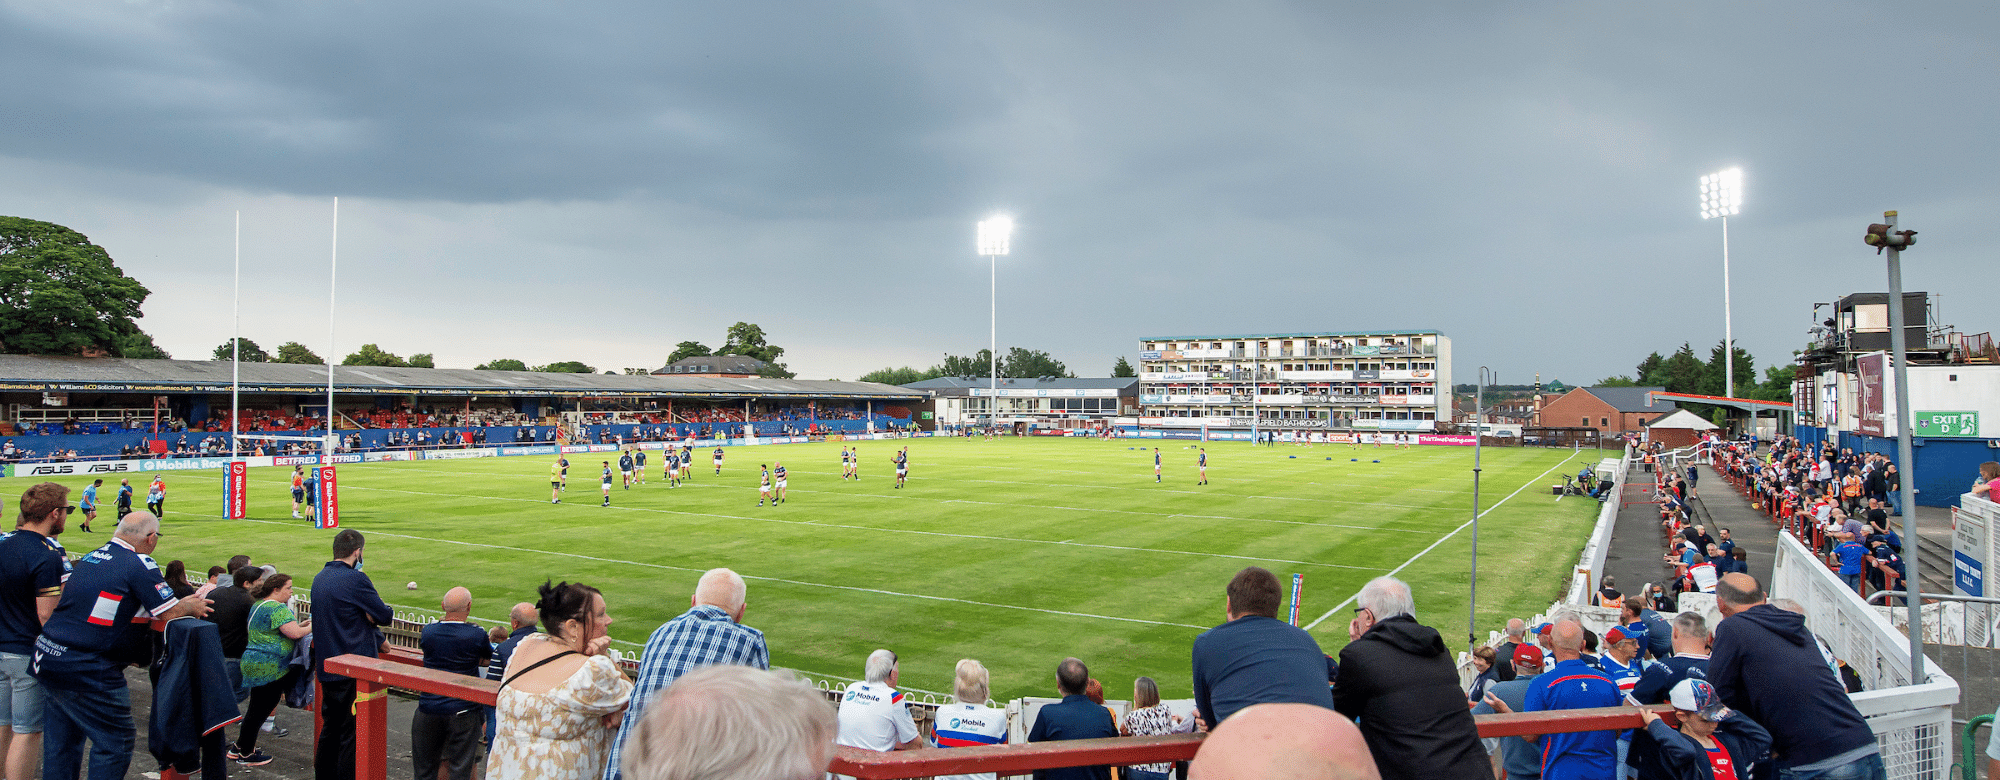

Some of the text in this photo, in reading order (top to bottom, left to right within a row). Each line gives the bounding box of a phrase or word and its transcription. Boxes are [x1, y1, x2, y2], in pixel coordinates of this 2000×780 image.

[1932, 415, 1958, 424] EXIT
[1942, 425, 1950, 433] D
[156, 460, 198, 470] Mobile
[275, 456, 317, 465] BETFRED
[31, 466, 73, 475] ASUS
[88, 464, 128, 473] ASUS
[326, 481, 335, 526] BETFRED
[50, 648, 62, 656] LTD
[856, 692, 880, 702] Mobile
[961, 719, 986, 728] Mobile
